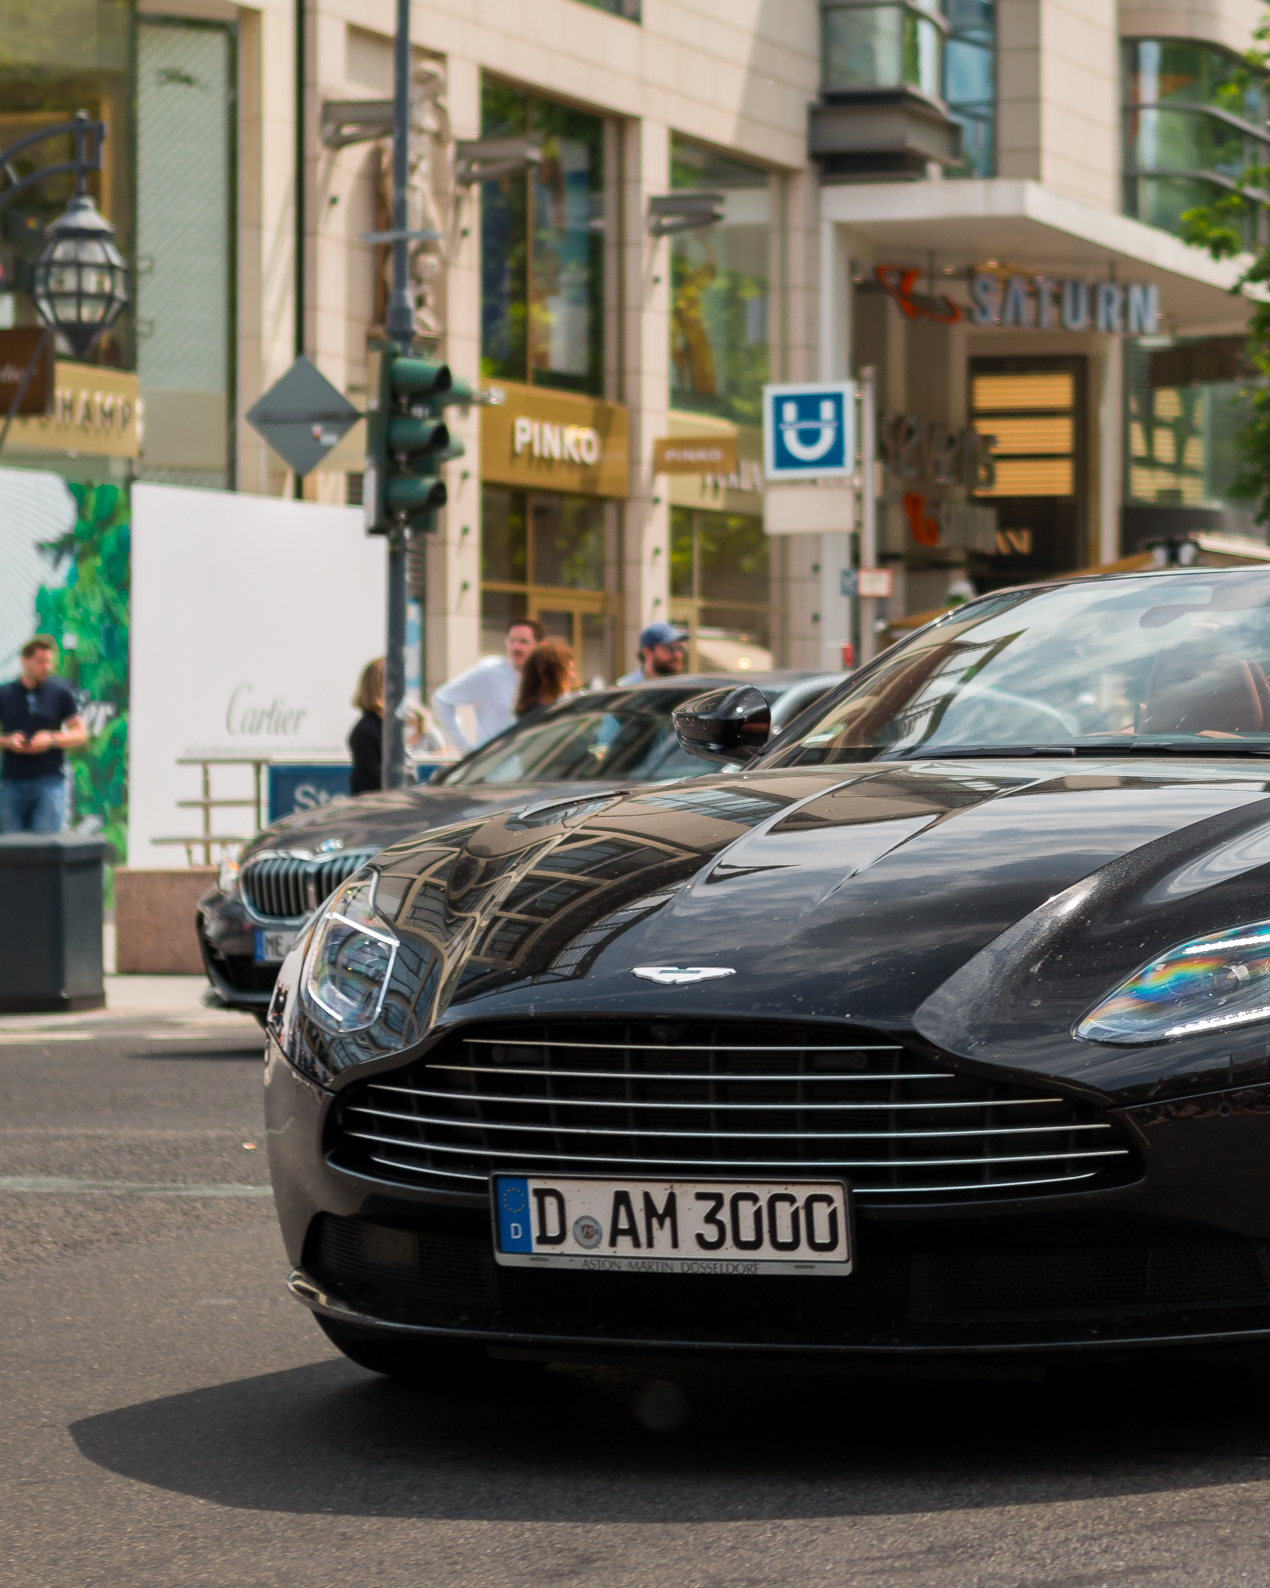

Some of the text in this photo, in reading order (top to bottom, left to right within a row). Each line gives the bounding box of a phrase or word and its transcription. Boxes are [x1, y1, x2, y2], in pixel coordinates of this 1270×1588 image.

[970, 274, 1160, 334] SATURN
[514, 416, 601, 465] PINKO
[664, 447, 724, 463] PINKO
[226, 681, 308, 737] Cartier
[532, 1187, 839, 1252] D AM 3000
[582, 1259, 622, 1270] ASTON
[627, 1262, 674, 1273] MARTIN
